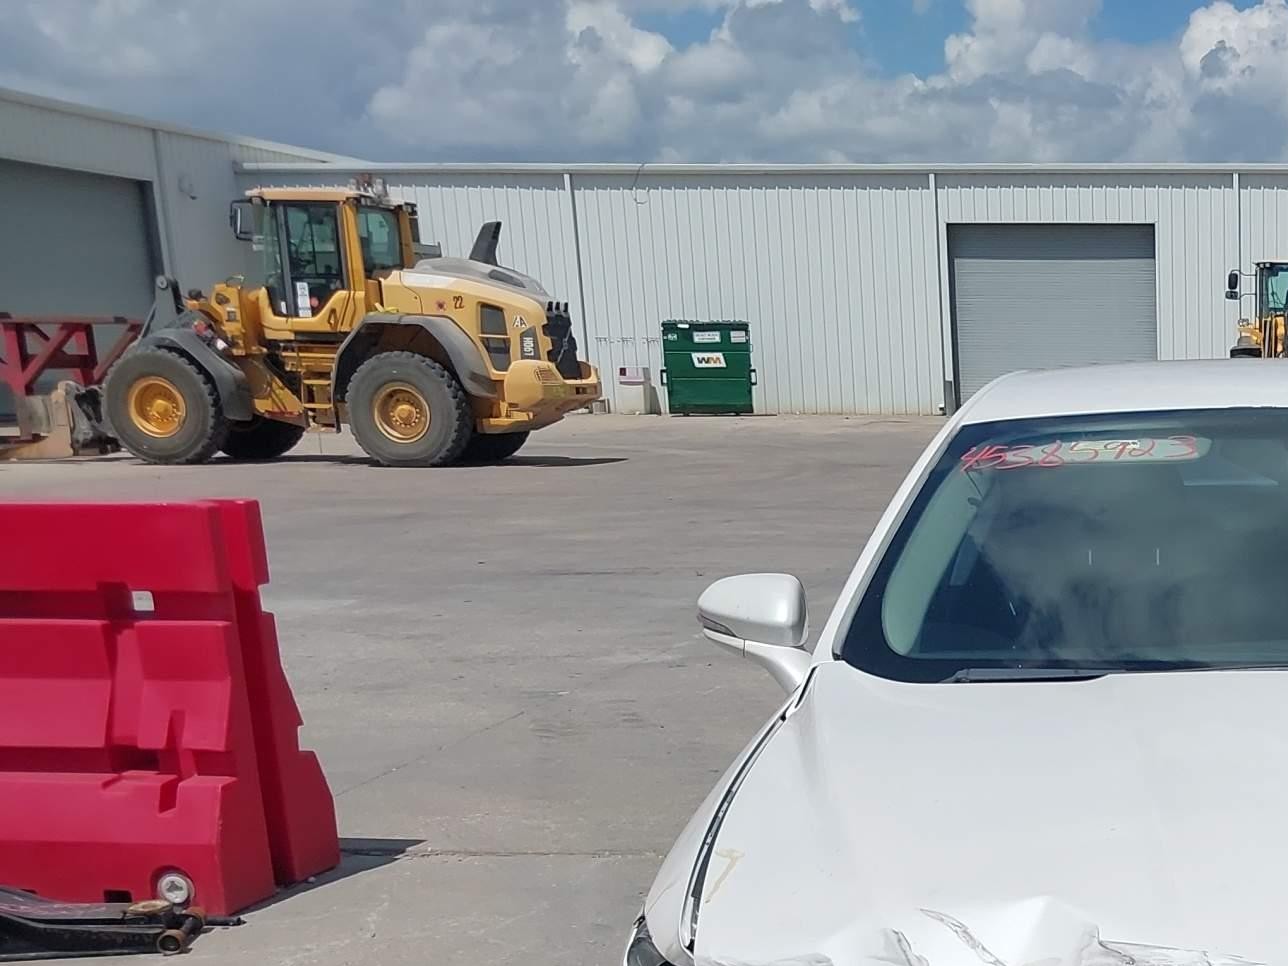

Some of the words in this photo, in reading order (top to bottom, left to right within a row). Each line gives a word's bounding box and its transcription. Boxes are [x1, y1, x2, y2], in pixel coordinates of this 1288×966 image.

[452, 295, 465, 310] 22
[522, 336, 535, 356] L90H
[696, 355, 723, 366] WM
[959, 435, 1198, 474] 45385923
